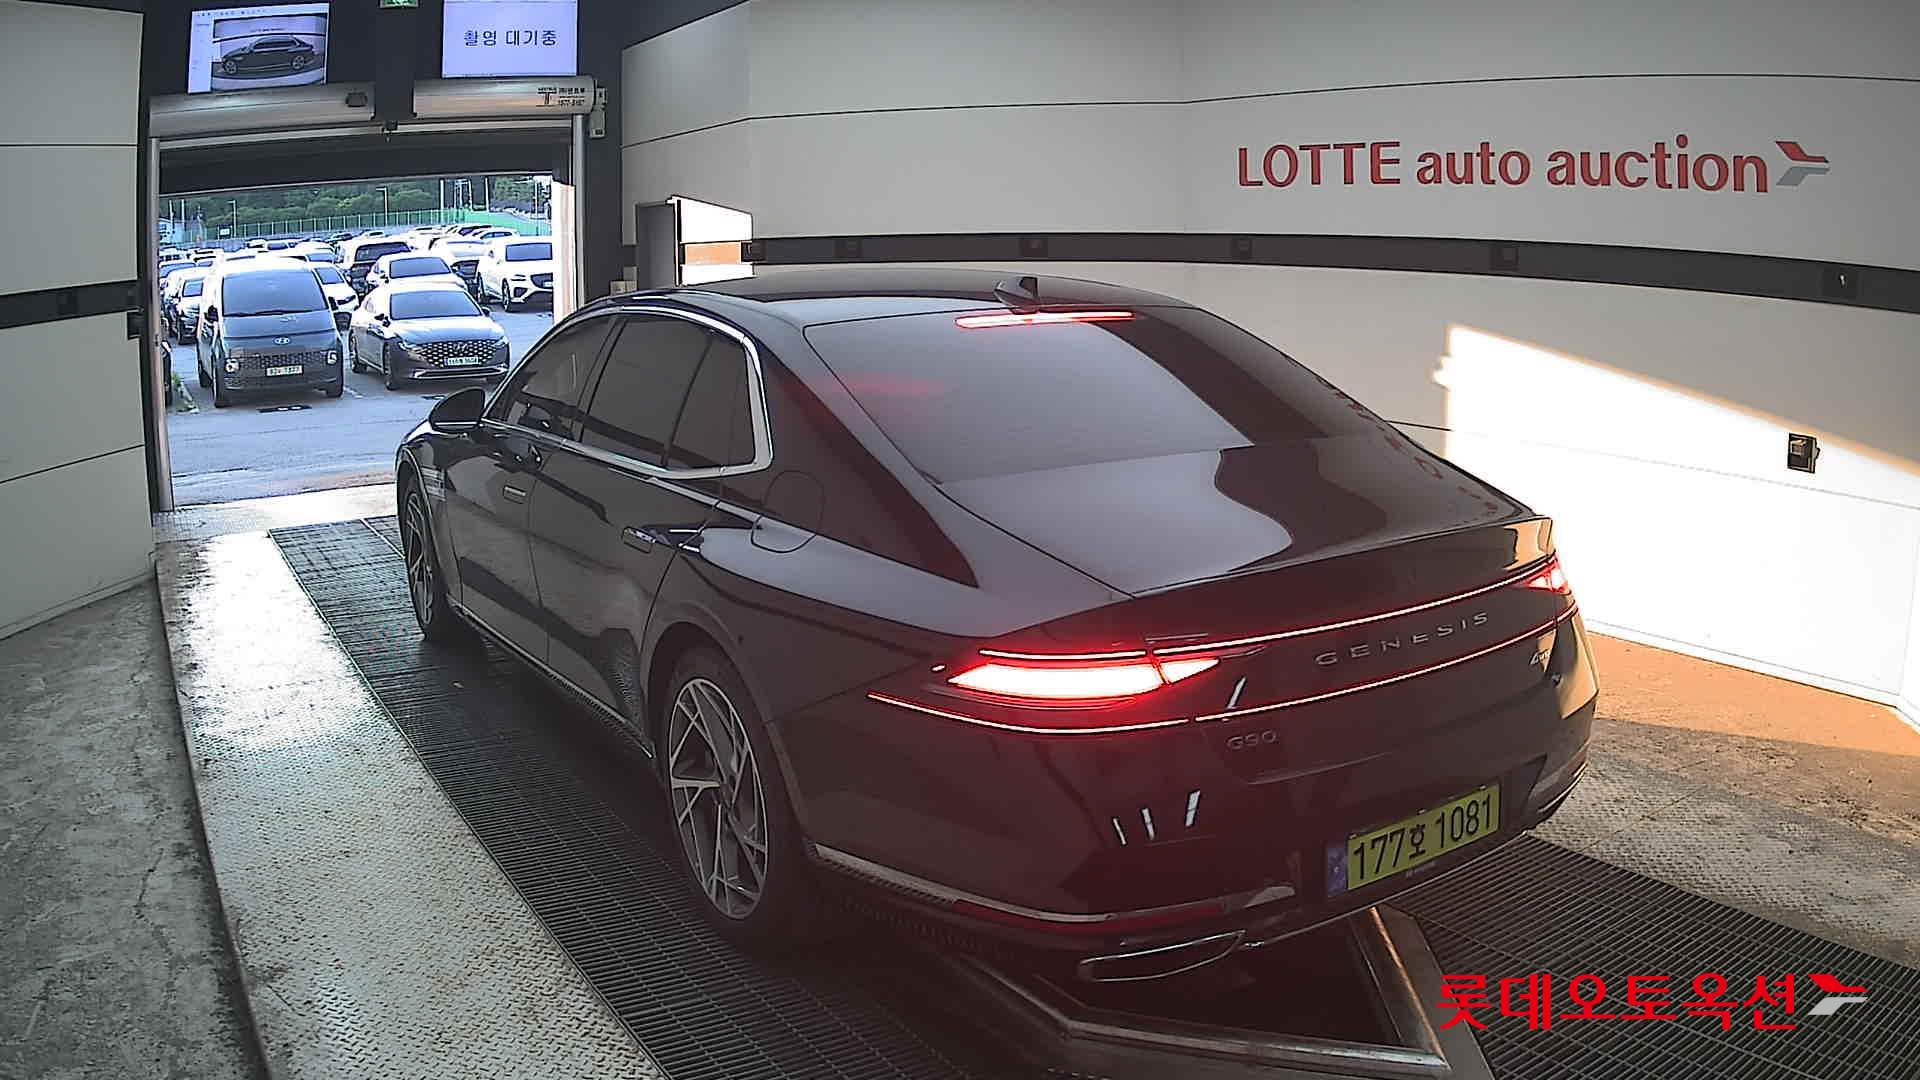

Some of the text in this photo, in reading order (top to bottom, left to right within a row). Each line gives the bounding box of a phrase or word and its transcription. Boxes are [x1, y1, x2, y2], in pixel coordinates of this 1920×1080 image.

[464, 30, 556, 46] 촬영 대기중
[1238, 134, 1769, 194] LOTTE auto auction
[1314, 612, 1488, 666] GENESIS
[1227, 730, 1277, 750] G90
[1353, 793, 1492, 880] 177호 1081
